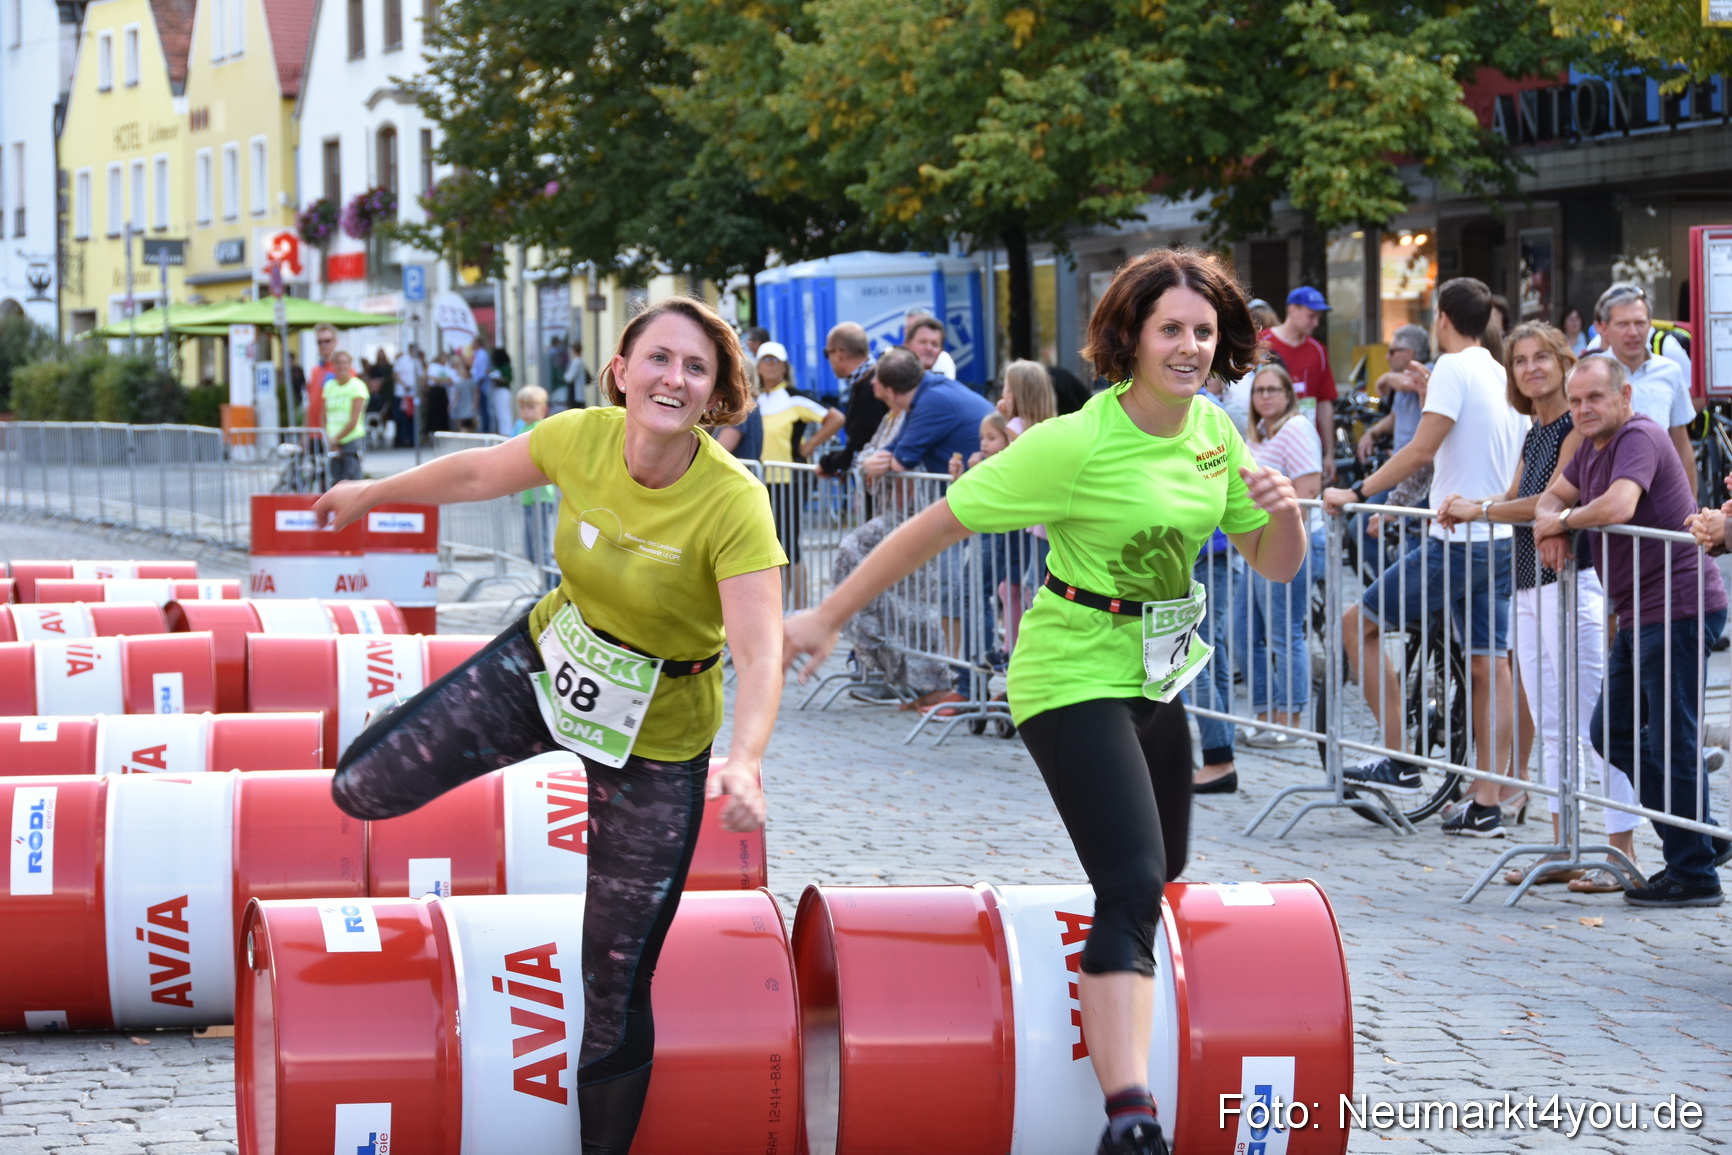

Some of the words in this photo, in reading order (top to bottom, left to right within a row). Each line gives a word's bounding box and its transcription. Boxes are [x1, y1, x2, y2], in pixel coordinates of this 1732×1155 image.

[1491, 76, 1636, 146] ANTON
[556, 606, 646, 688] BOCK
[555, 661, 600, 713] 68
